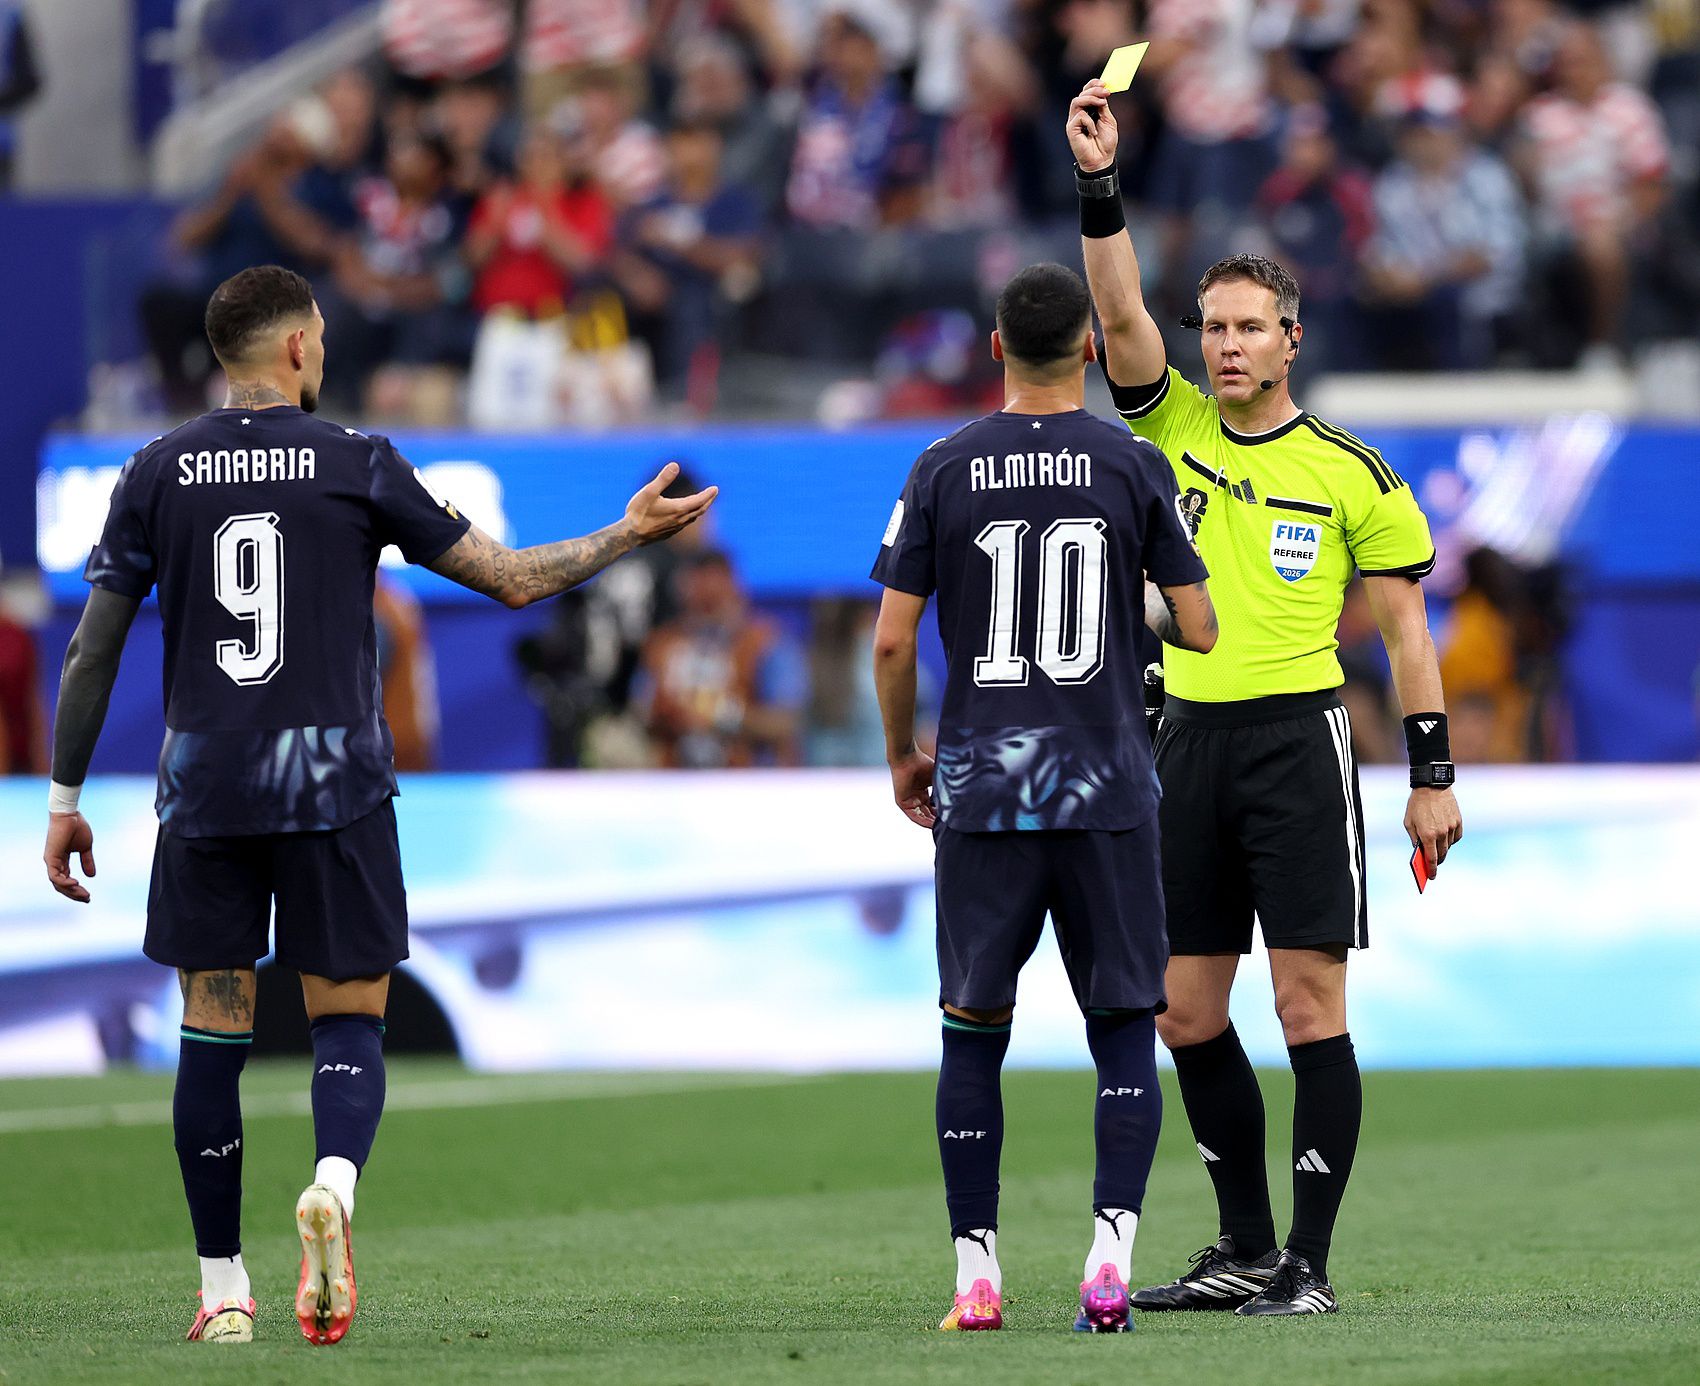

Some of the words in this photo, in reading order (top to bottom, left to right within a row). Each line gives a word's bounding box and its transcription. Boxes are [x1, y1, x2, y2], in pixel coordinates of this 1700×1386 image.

[178, 447, 316, 486] SANABRIA
[970, 448, 1091, 491] ALMIRÓN
[1276, 524, 1316, 543] FIFA
[1273, 548, 1314, 560] REFEREE
[1282, 568, 1301, 578] 2026
[213, 511, 285, 687] 9
[973, 517, 1108, 688] 10
[318, 1063, 362, 1075] APF
[1100, 1087, 1144, 1098] APF
[943, 1130, 986, 1139] APF
